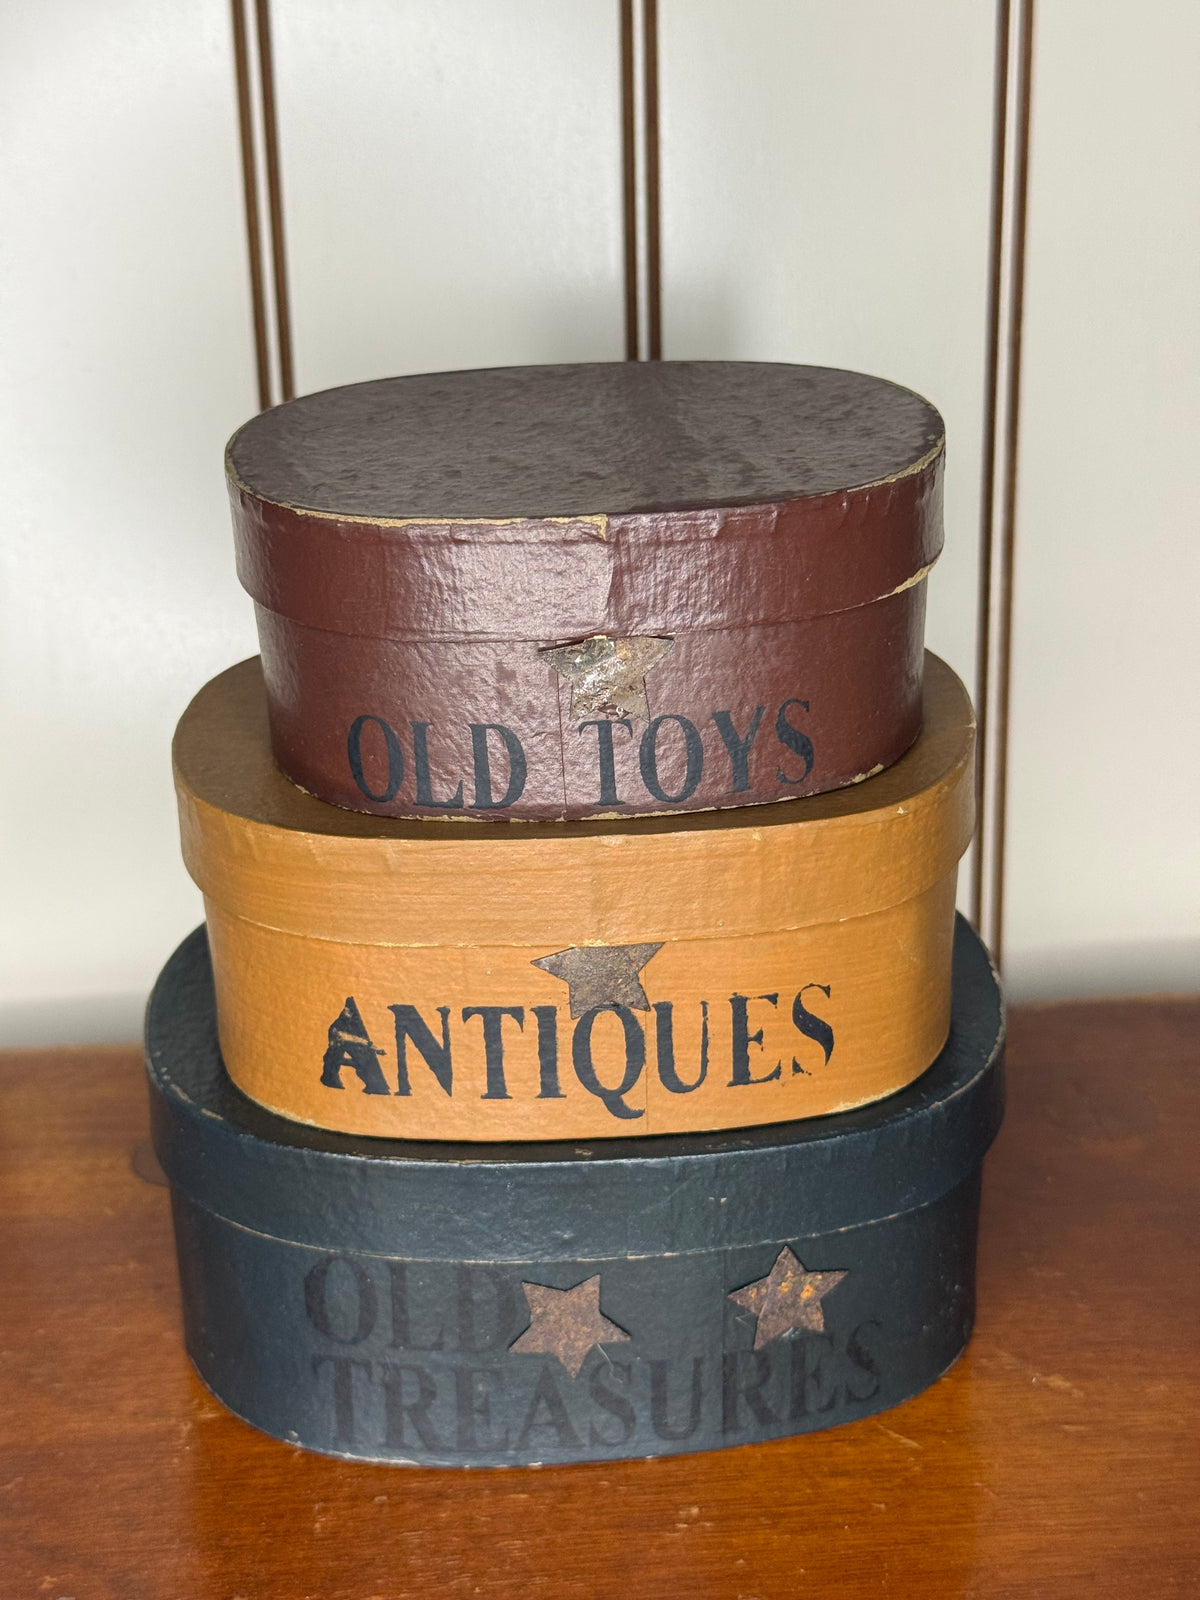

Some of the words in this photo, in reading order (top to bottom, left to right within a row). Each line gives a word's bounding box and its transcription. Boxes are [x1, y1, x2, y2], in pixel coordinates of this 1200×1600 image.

[347, 714, 528, 809] OLD
[579, 699, 814, 805] TOYS
[320, 983, 834, 1118] ANTIQUES
[303, 1255, 518, 1352] OLD
[311, 1318, 883, 1452] TREASURES
